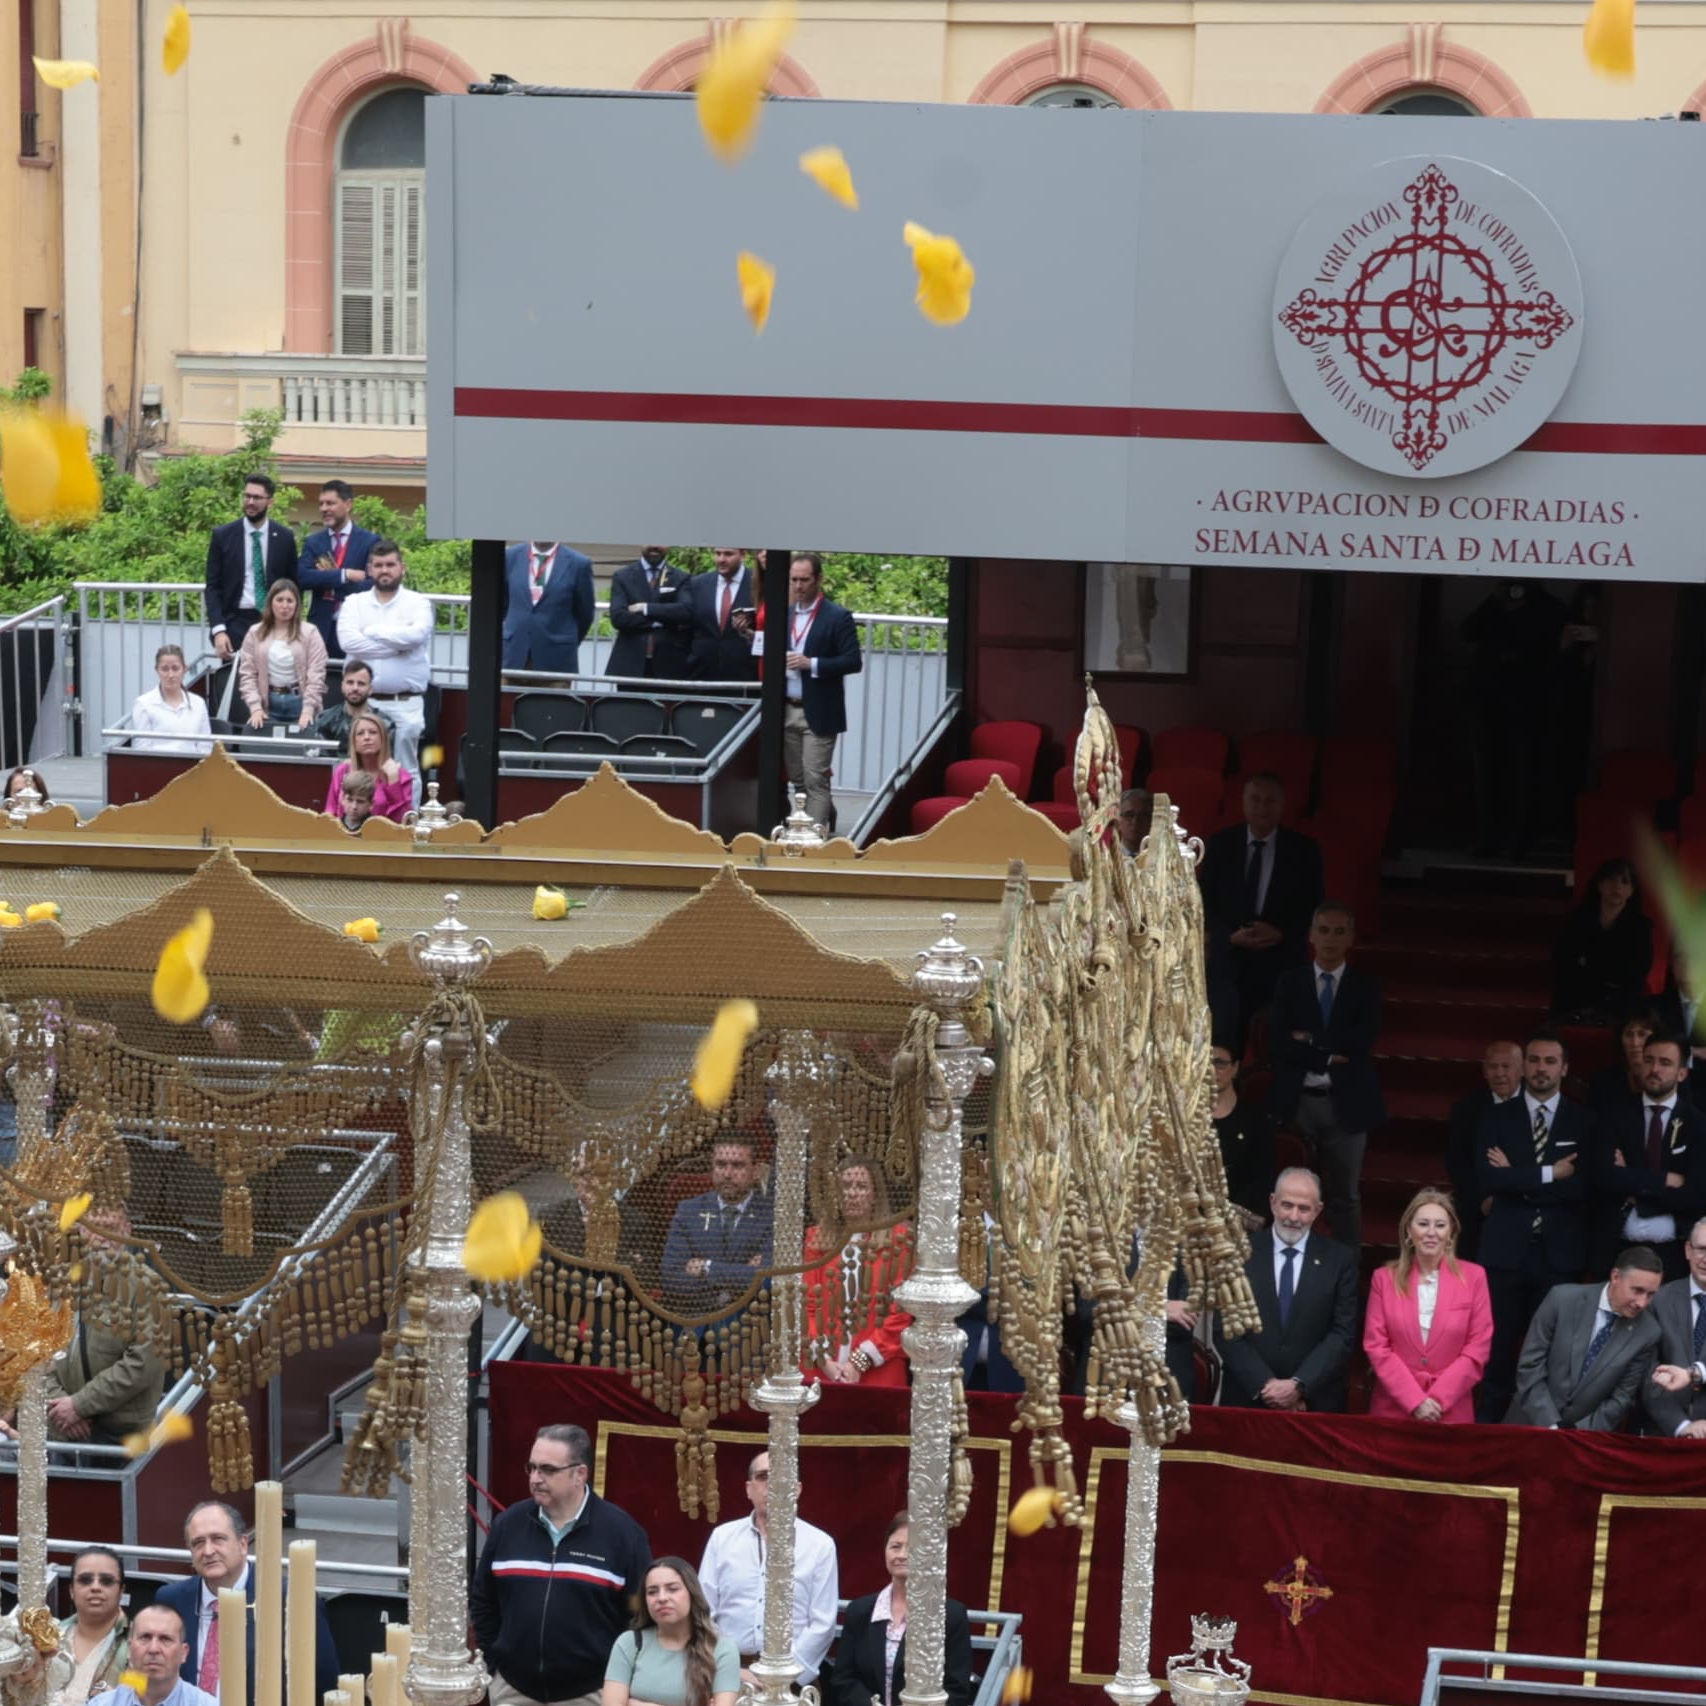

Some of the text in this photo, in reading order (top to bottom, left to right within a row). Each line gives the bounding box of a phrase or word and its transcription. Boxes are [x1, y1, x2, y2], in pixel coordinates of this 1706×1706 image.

[1447, 496, 1627, 526] COFRADIAS
[1194, 528, 1332, 559] SEMANA
[1339, 531, 1445, 562] SANTA
[1489, 538, 1637, 568] MALAGA
